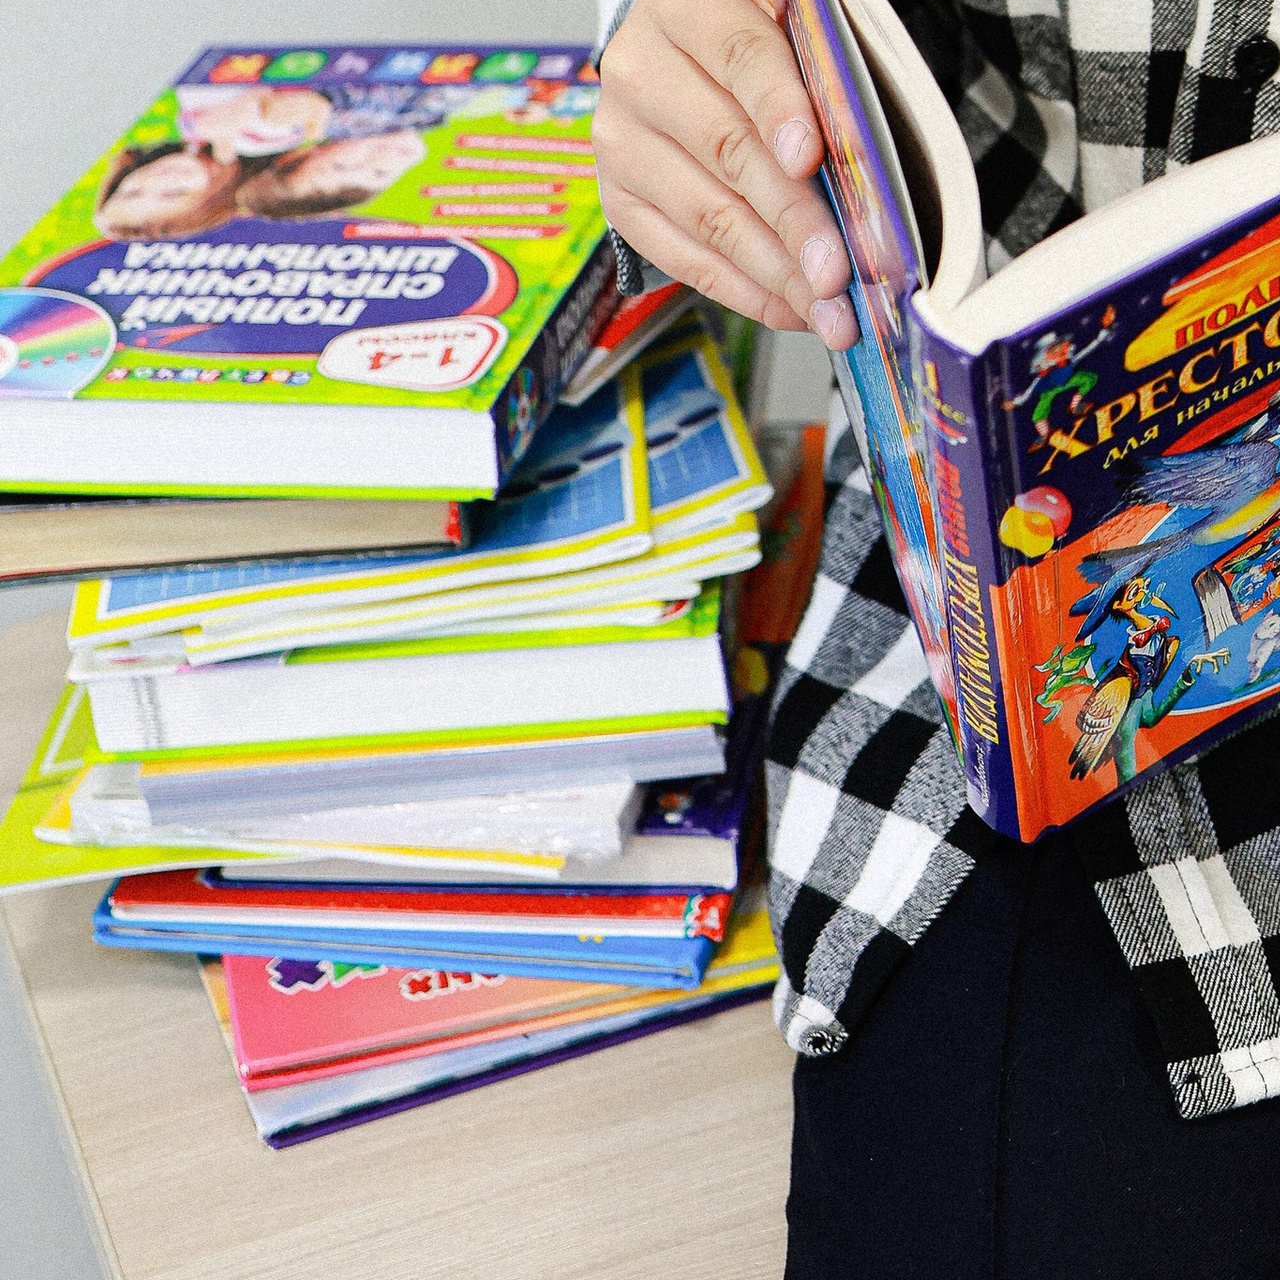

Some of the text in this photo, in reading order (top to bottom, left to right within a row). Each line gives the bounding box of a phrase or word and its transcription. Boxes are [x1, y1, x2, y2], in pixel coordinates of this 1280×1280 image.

[123, 241, 460, 272] ШКОЛЬНИКА
[86, 268, 446, 300] СПРАВОЧНИК
[119, 295, 368, 331] ПОЛНЫЙ
[1102, 424, 1159, 470] для
[943, 548, 999, 745] ХРЕСТОМАТИЯ
